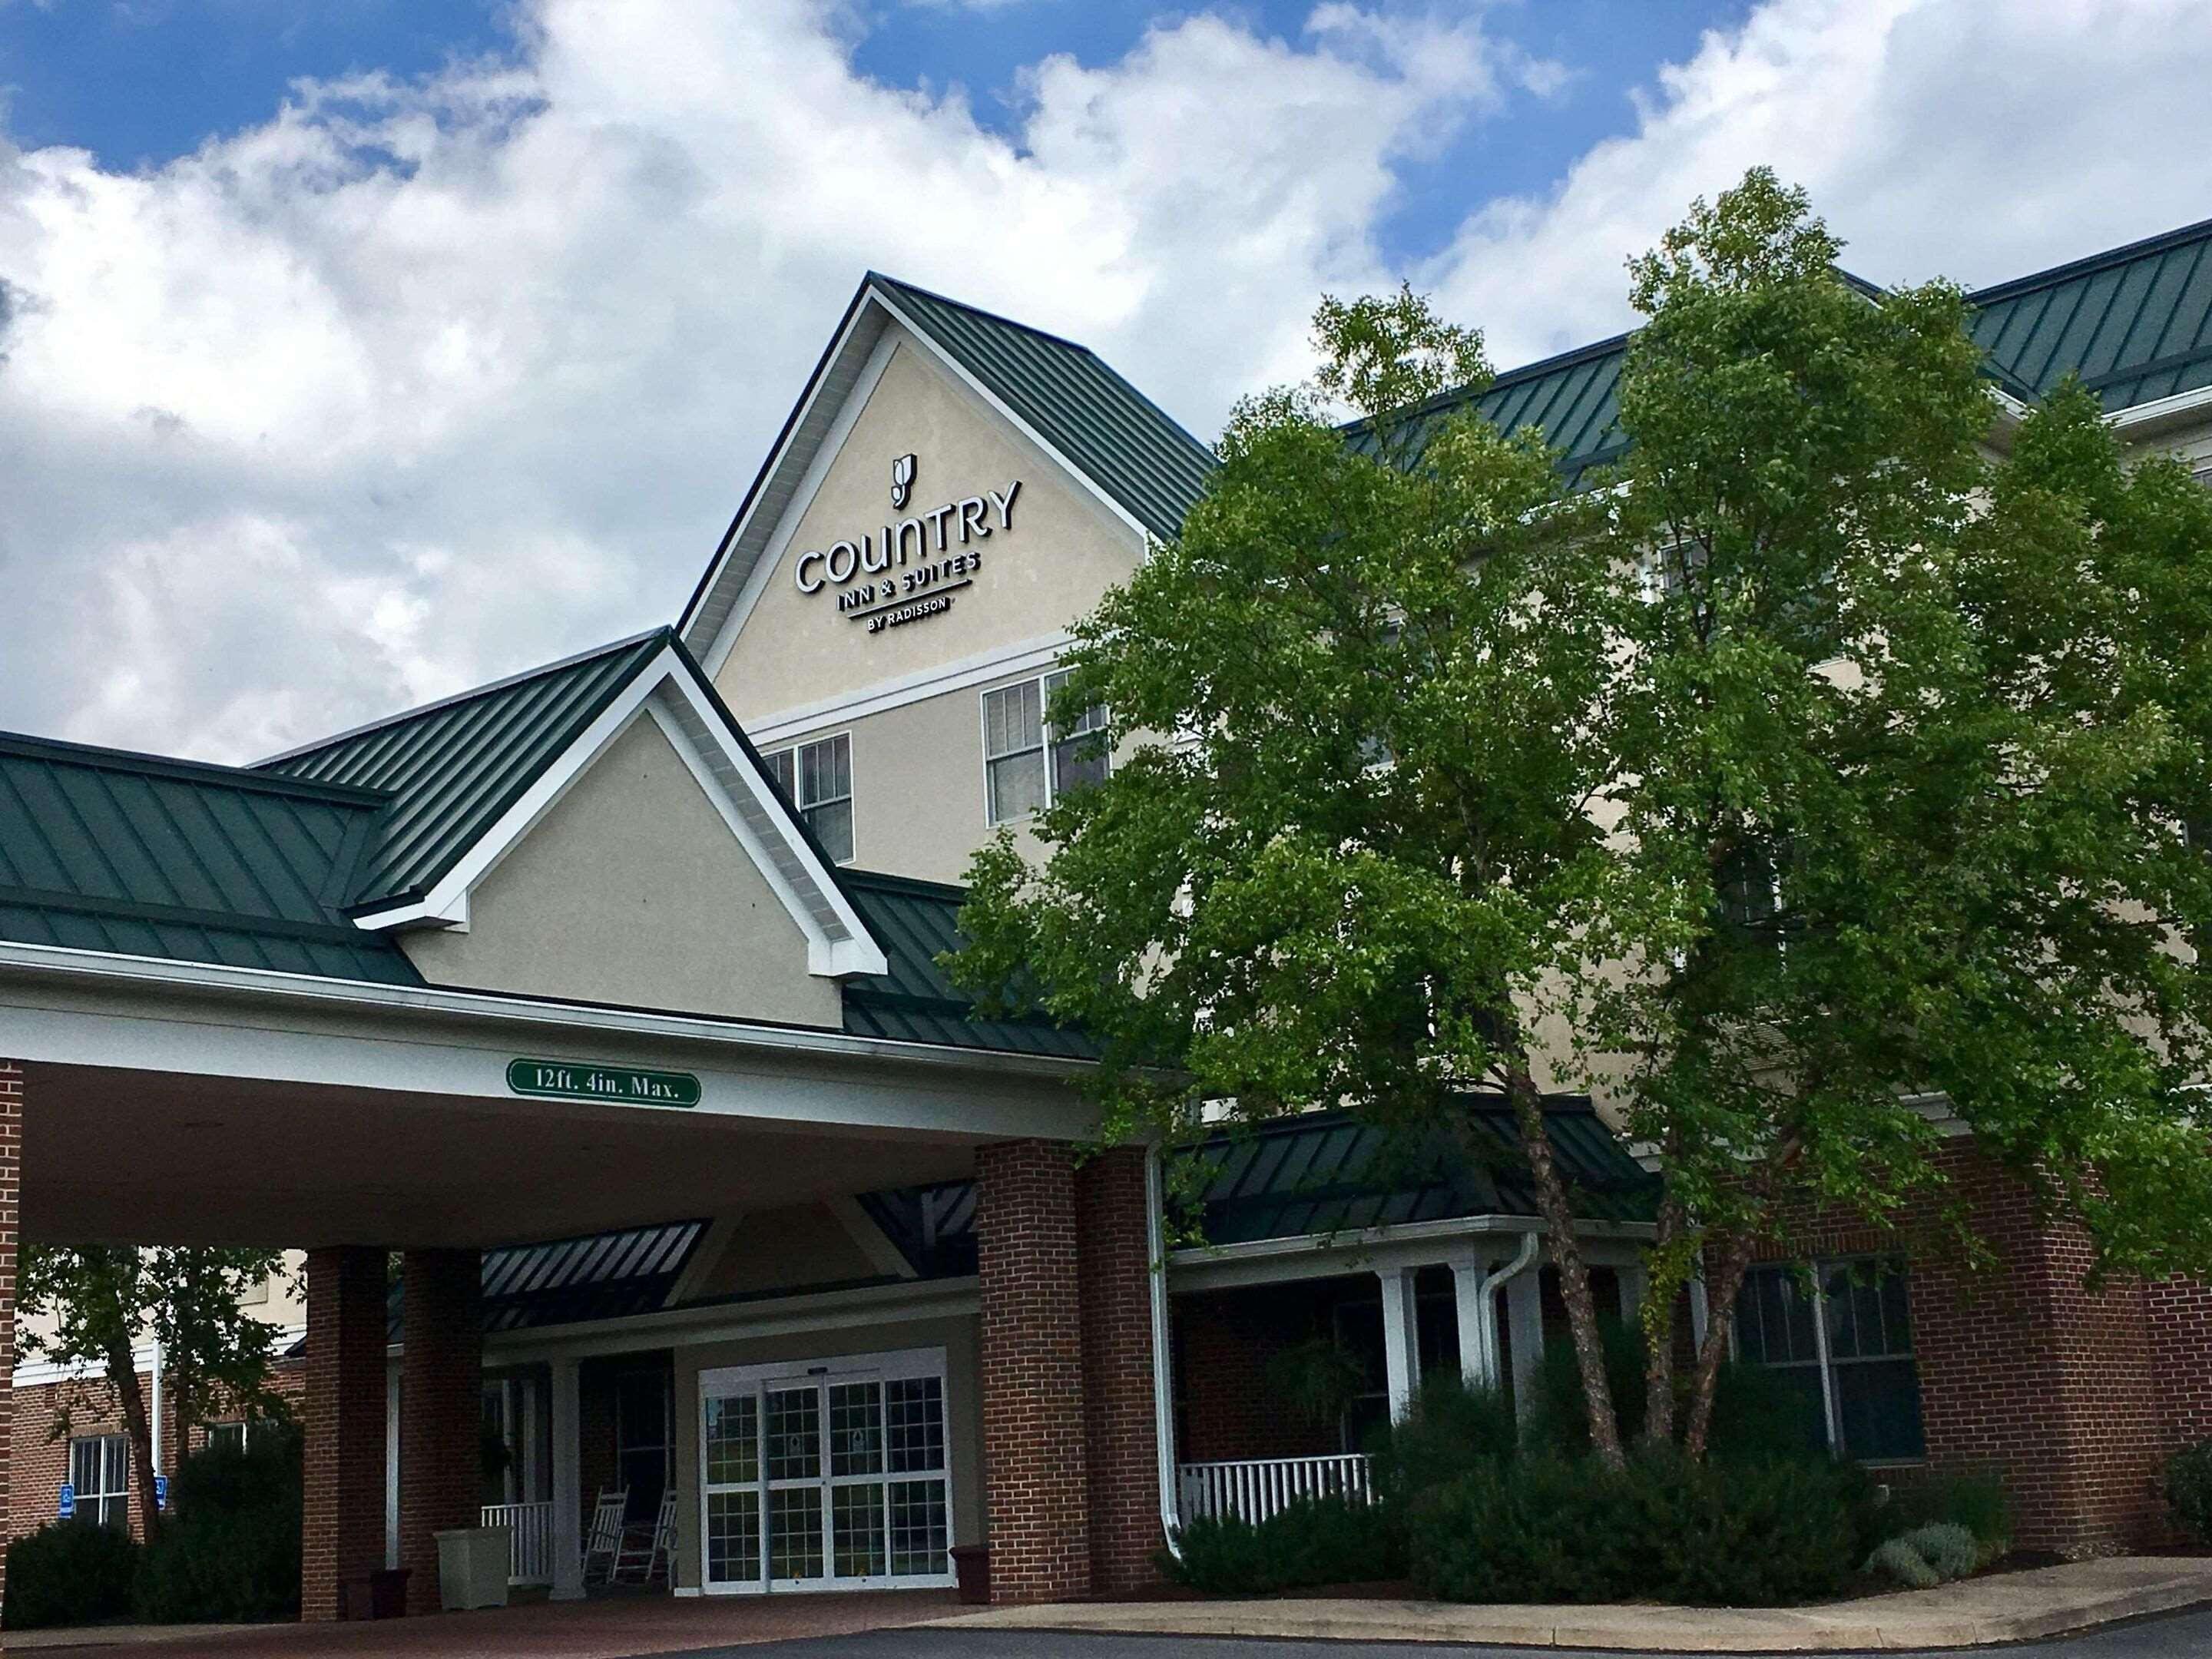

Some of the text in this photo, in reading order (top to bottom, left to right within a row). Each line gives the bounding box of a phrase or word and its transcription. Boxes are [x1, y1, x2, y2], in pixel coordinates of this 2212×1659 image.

[836, 551, 981, 611] INN & SUITES
[866, 596, 950, 633] BY RADISSON
[535, 1068, 680, 1098] 12ft. 4in. Max.
